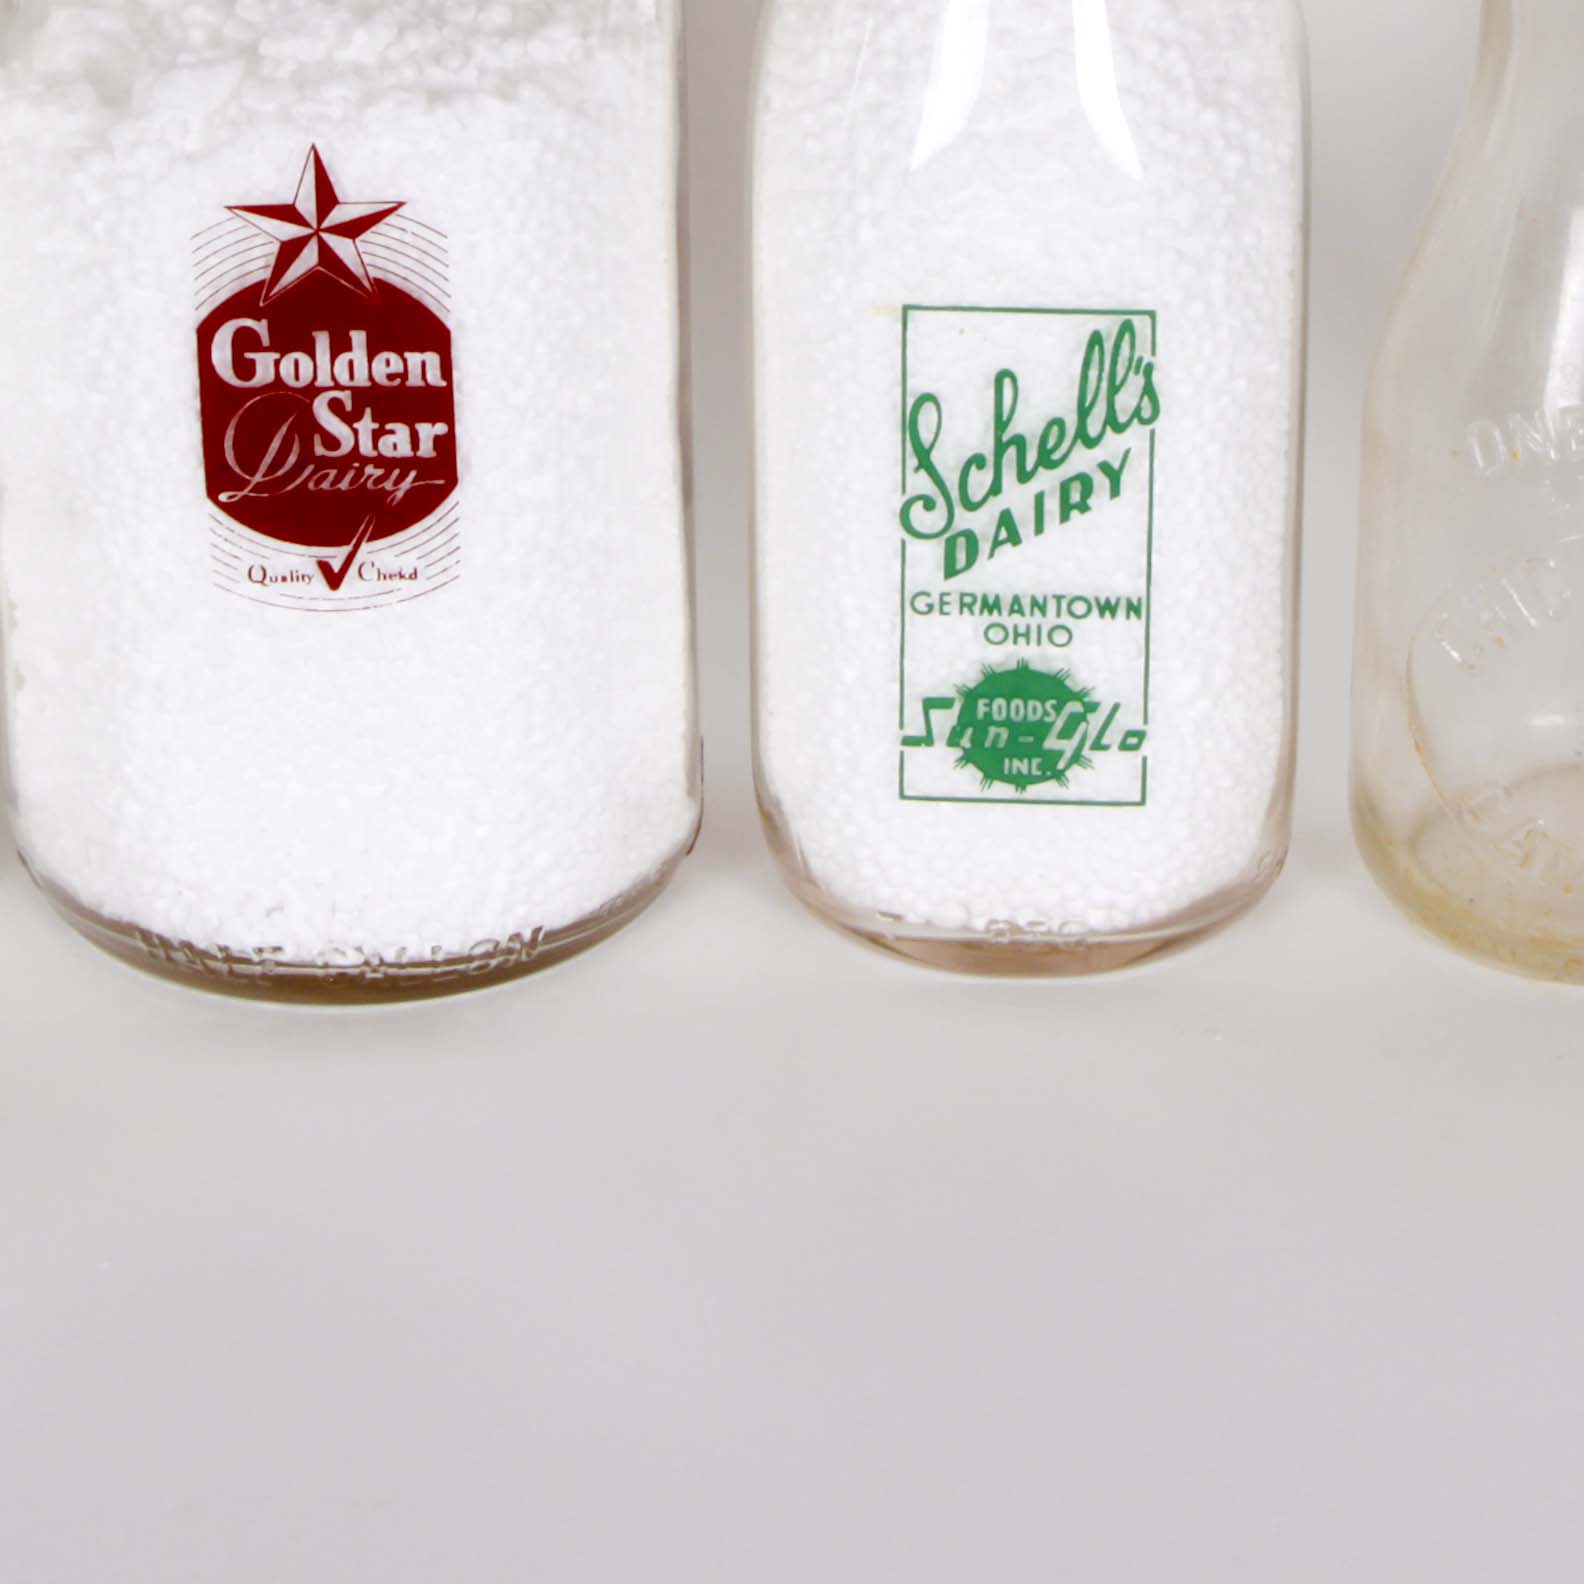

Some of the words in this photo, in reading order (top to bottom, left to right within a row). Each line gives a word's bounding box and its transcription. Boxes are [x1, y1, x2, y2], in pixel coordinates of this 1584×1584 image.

[211, 317, 448, 389] Golden
[217, 390, 445, 507] Dairy
[311, 388, 449, 459] Star
[899, 318, 1161, 540] Schell's
[943, 447, 1132, 581] DAIRY
[247, 563, 314, 587] Quality
[910, 590, 1143, 621] GERMANTOWN
[982, 622, 1074, 648] OHIO
[976, 697, 1058, 723] FOODS
